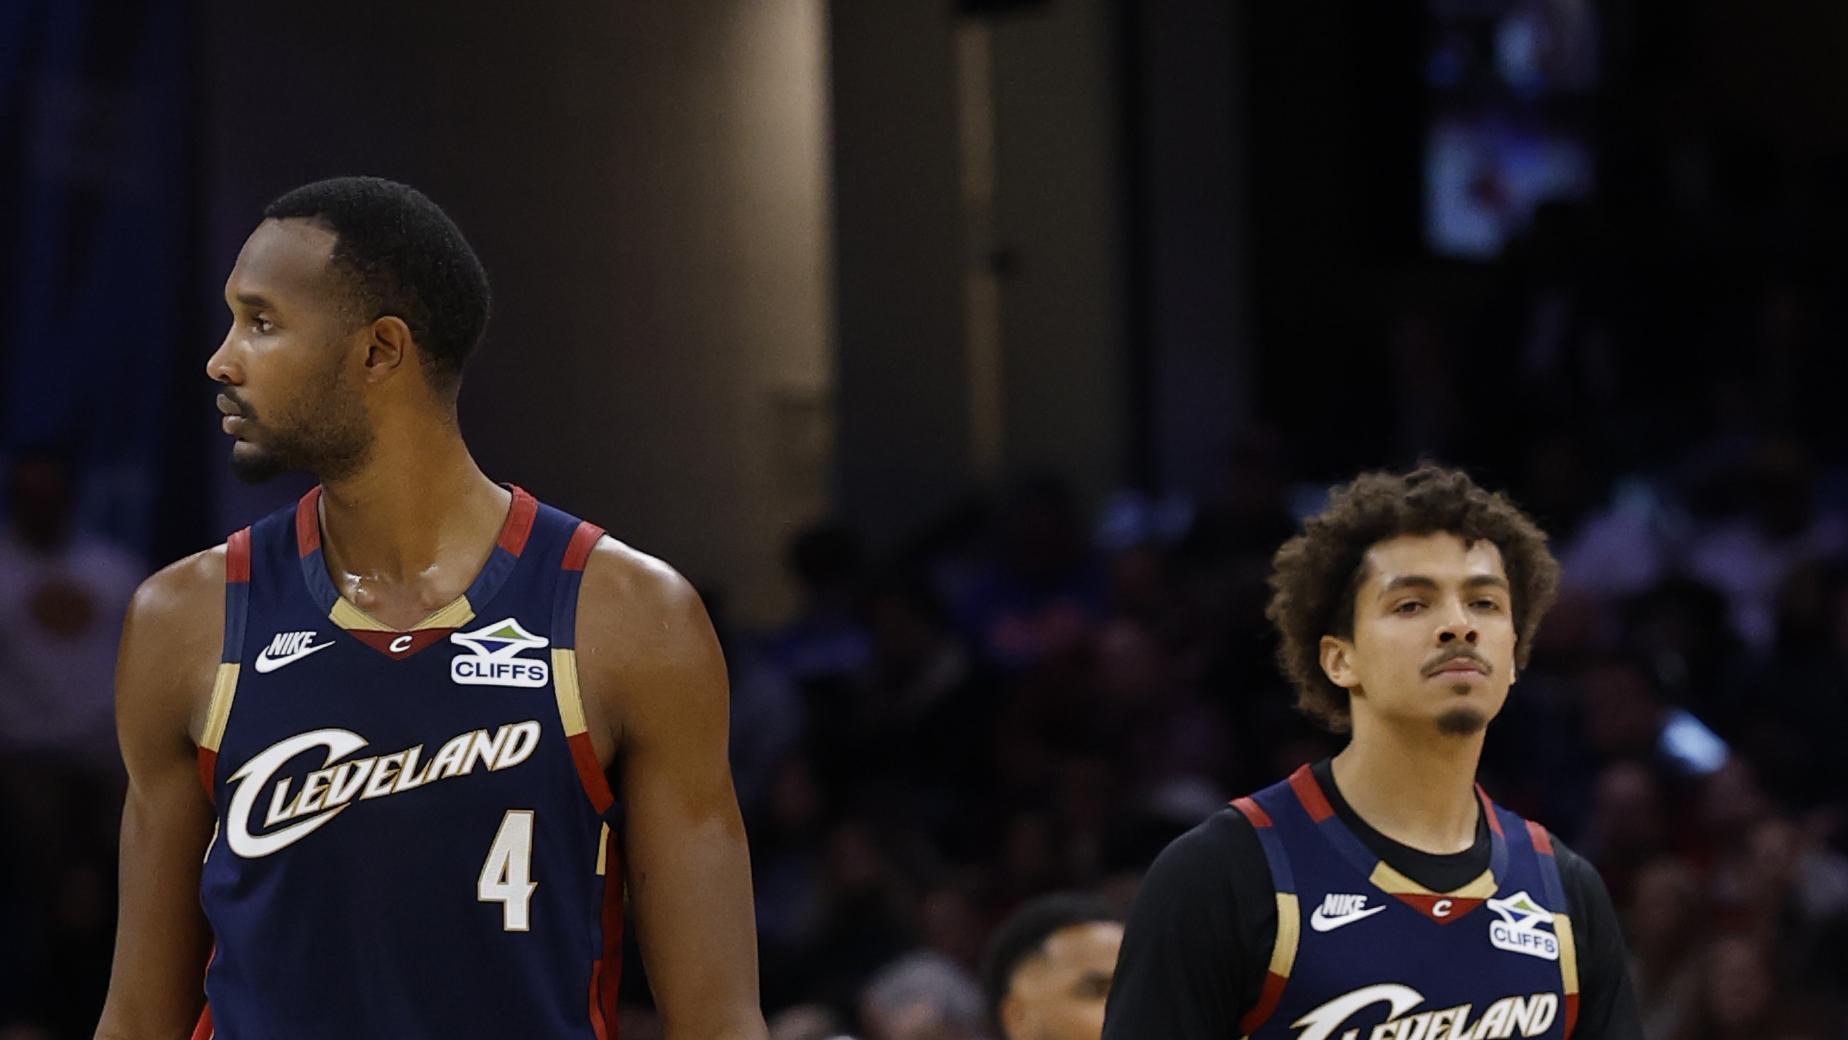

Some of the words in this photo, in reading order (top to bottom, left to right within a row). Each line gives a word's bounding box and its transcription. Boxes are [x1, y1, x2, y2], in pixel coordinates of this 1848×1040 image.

[266, 631, 317, 656] NIKE
[389, 635, 412, 653] C
[455, 660, 545, 682] CLIFFS
[226, 720, 541, 858] CLEVELAND
[477, 810, 538, 931] 4
[1323, 893, 1367, 915] NIKE
[1432, 900, 1452, 917] C
[1493, 927, 1556, 954] CLIFFS
